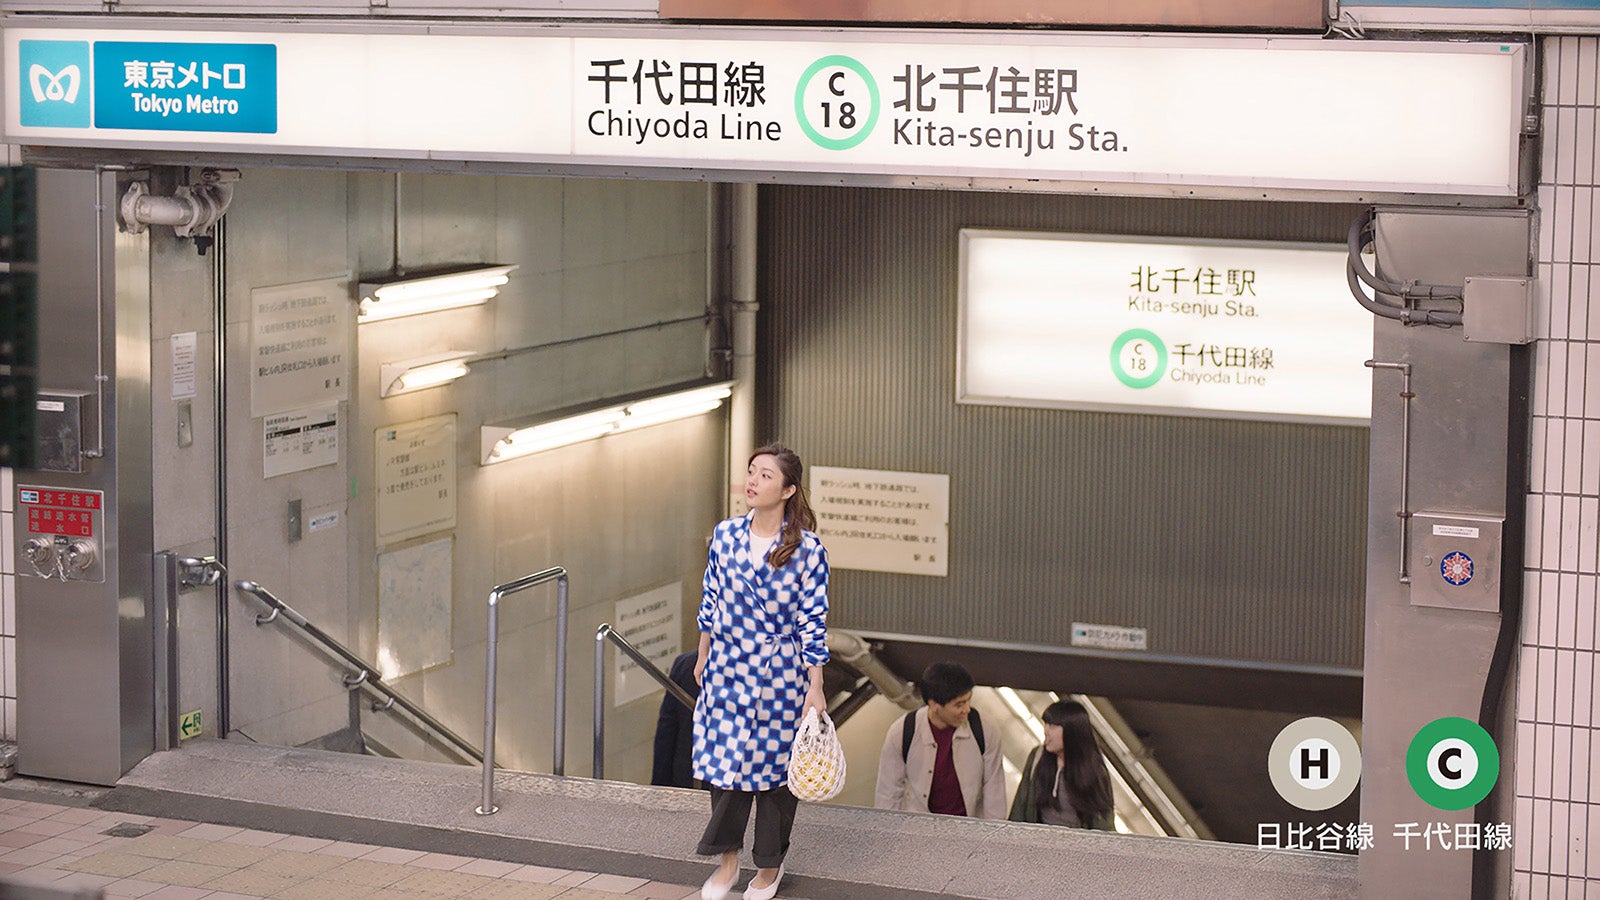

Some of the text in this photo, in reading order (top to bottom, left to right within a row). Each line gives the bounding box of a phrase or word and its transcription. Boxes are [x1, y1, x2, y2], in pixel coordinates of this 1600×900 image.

[123, 59, 246, 90] 東京メトロ
[587, 58, 766, 107] 千代田線
[828, 71, 845, 97] C
[892, 64, 1079, 117] 北千住駅
[131, 93, 239, 117] Tokyo Metro
[820, 101, 856, 130] 18
[588, 110, 782, 145] Chiyoda Line
[893, 118, 1129, 157] Kita-senju Sta.
[1130, 265, 1256, 297] 北千住駅
[1128, 295, 1260, 318] Kita-senju Sta.
[1133, 342, 1143, 355] C
[1171, 342, 1275, 370] 千代田線
[1131, 357, 1147, 371] 18
[1170, 367, 1267, 387] Chiyoda Line
[43, 492, 95, 507] 北千住駅
